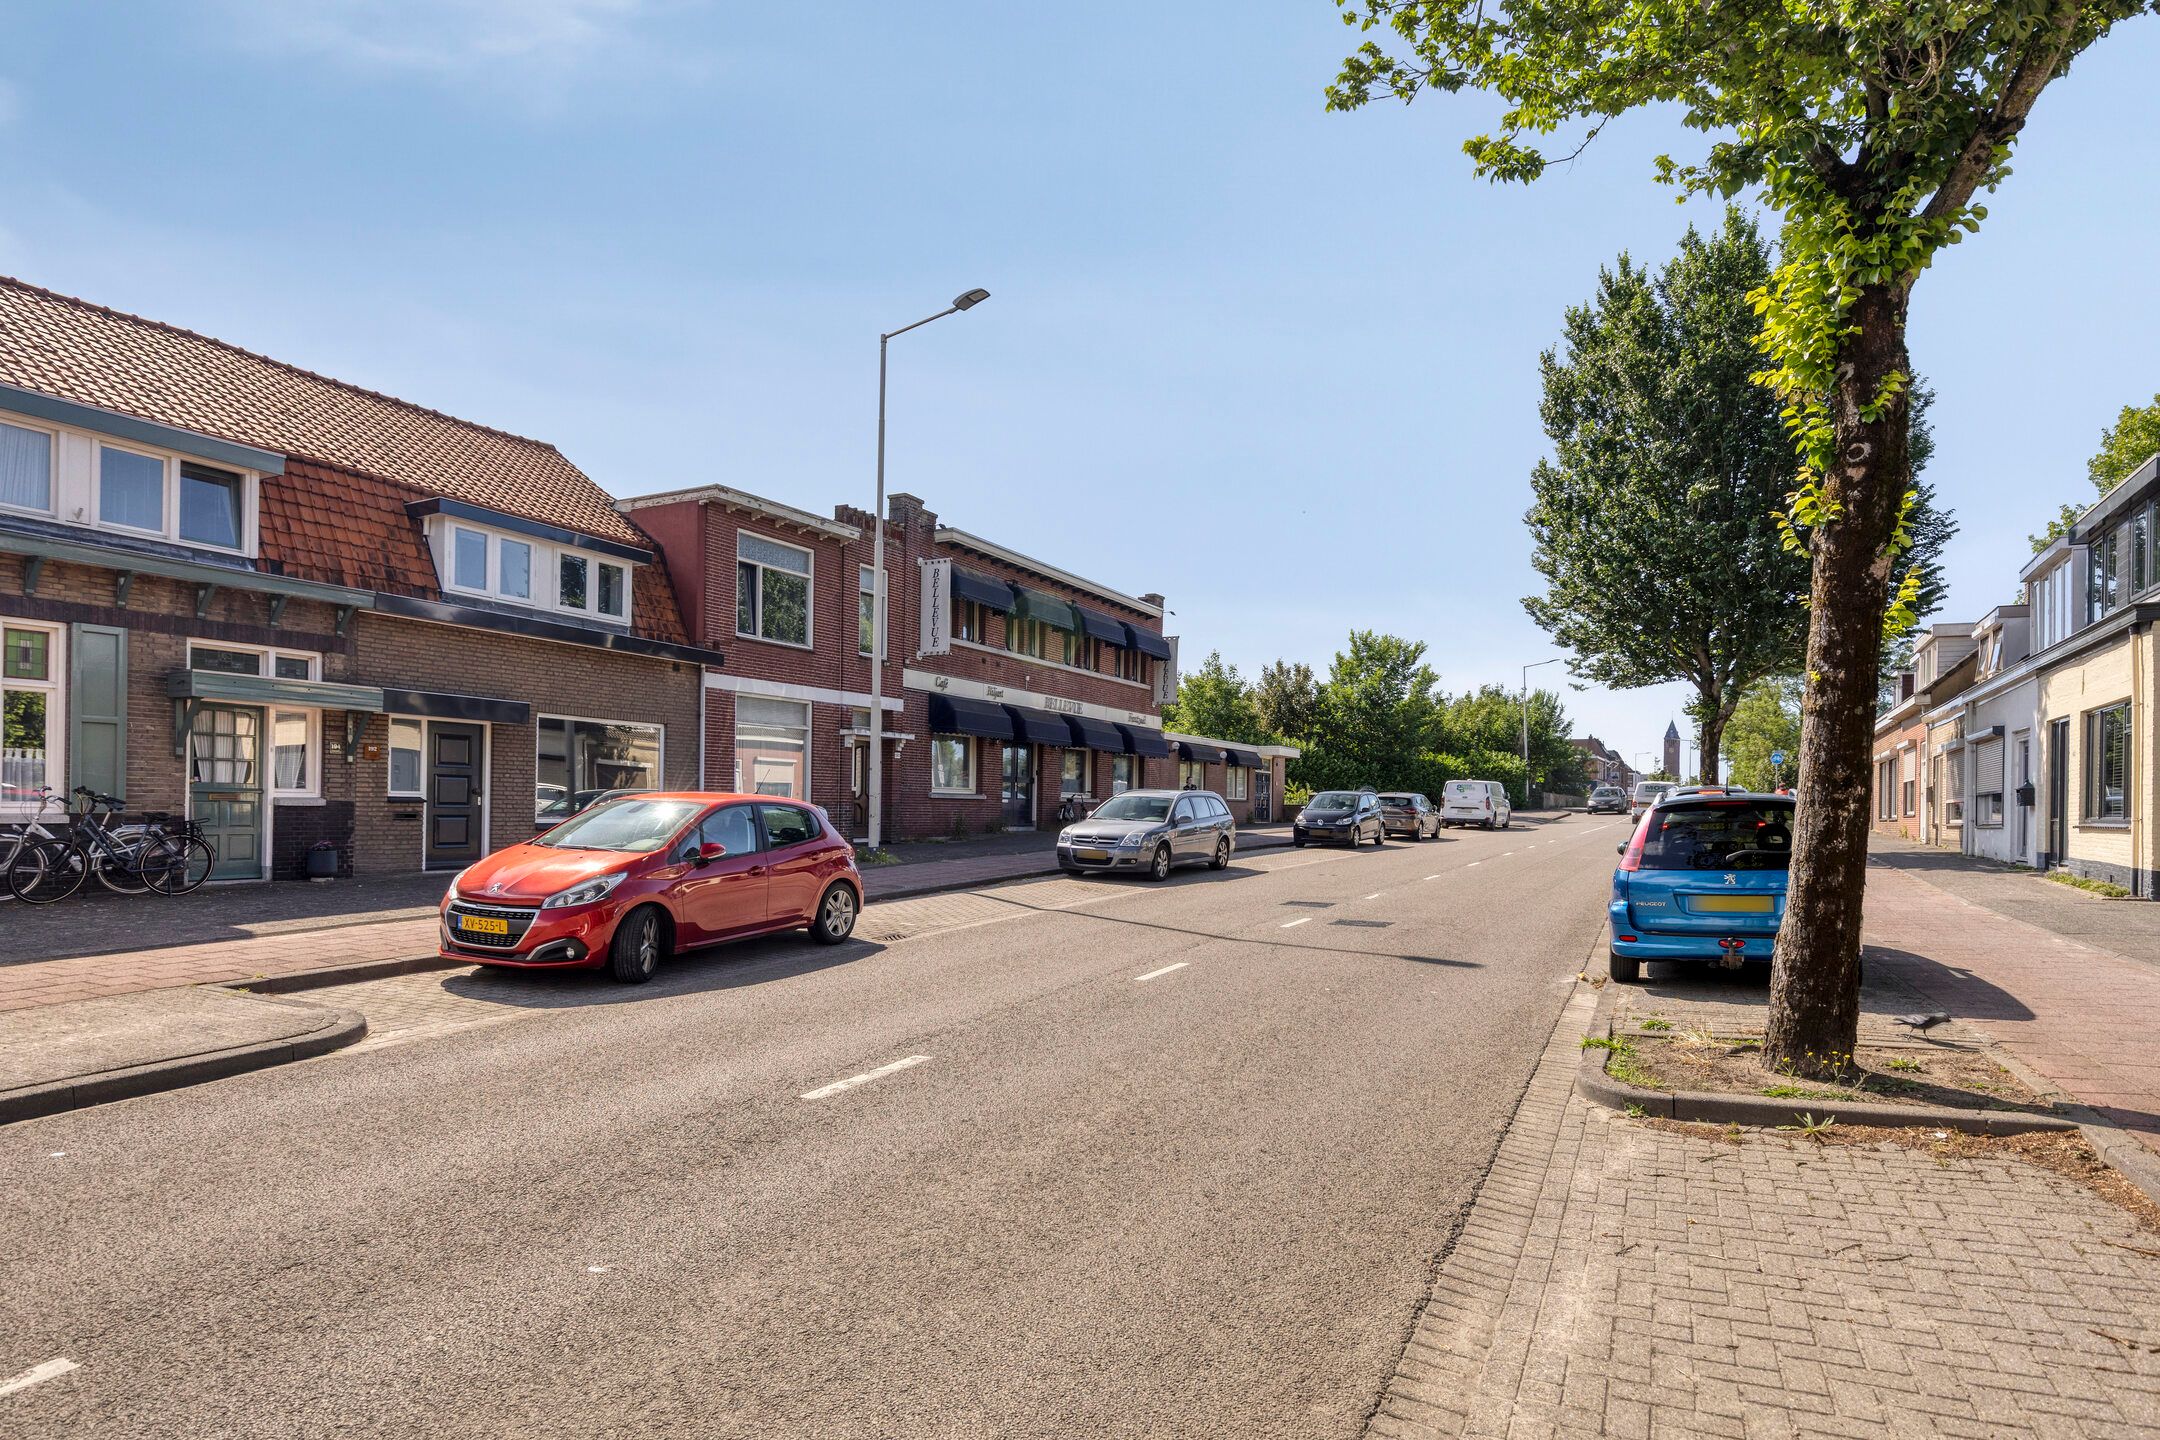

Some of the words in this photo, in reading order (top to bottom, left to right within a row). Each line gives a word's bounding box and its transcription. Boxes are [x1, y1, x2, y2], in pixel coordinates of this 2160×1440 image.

[931, 567, 940, 648] BELLEVUE
[1044, 696, 1084, 715] BELLEVUE
[463, 917, 504, 933] XV-525-L
